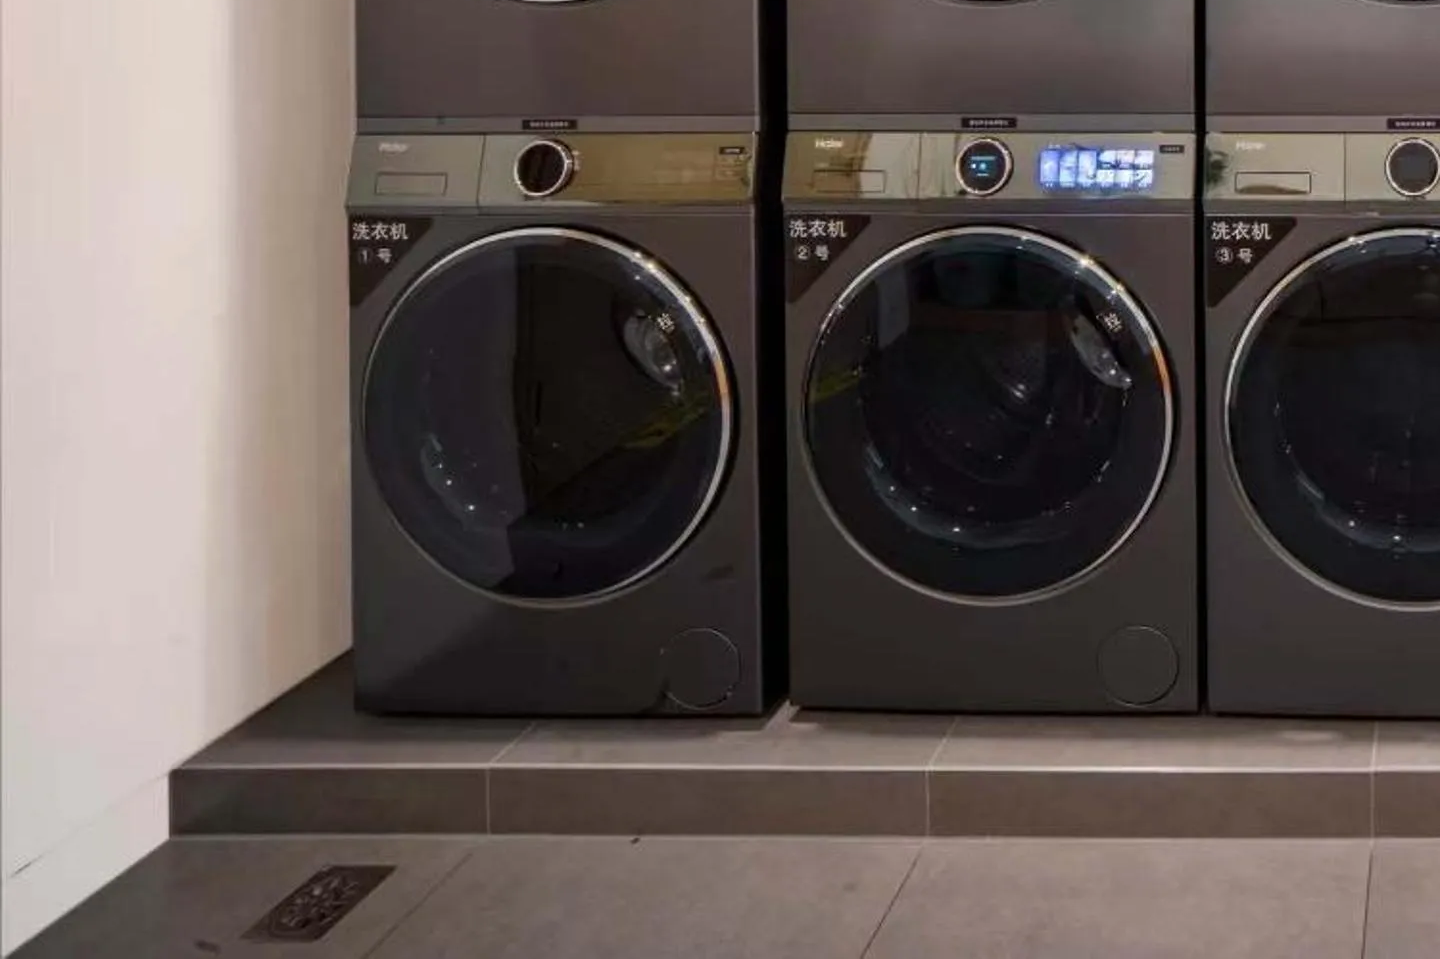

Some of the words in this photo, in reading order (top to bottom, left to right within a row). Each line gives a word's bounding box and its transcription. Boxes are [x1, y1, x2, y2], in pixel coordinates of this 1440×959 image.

[352, 222, 409, 240] 洗衣机
[789, 220, 847, 238] 洗衣机
[1211, 221, 1271, 240] 洗衣机
